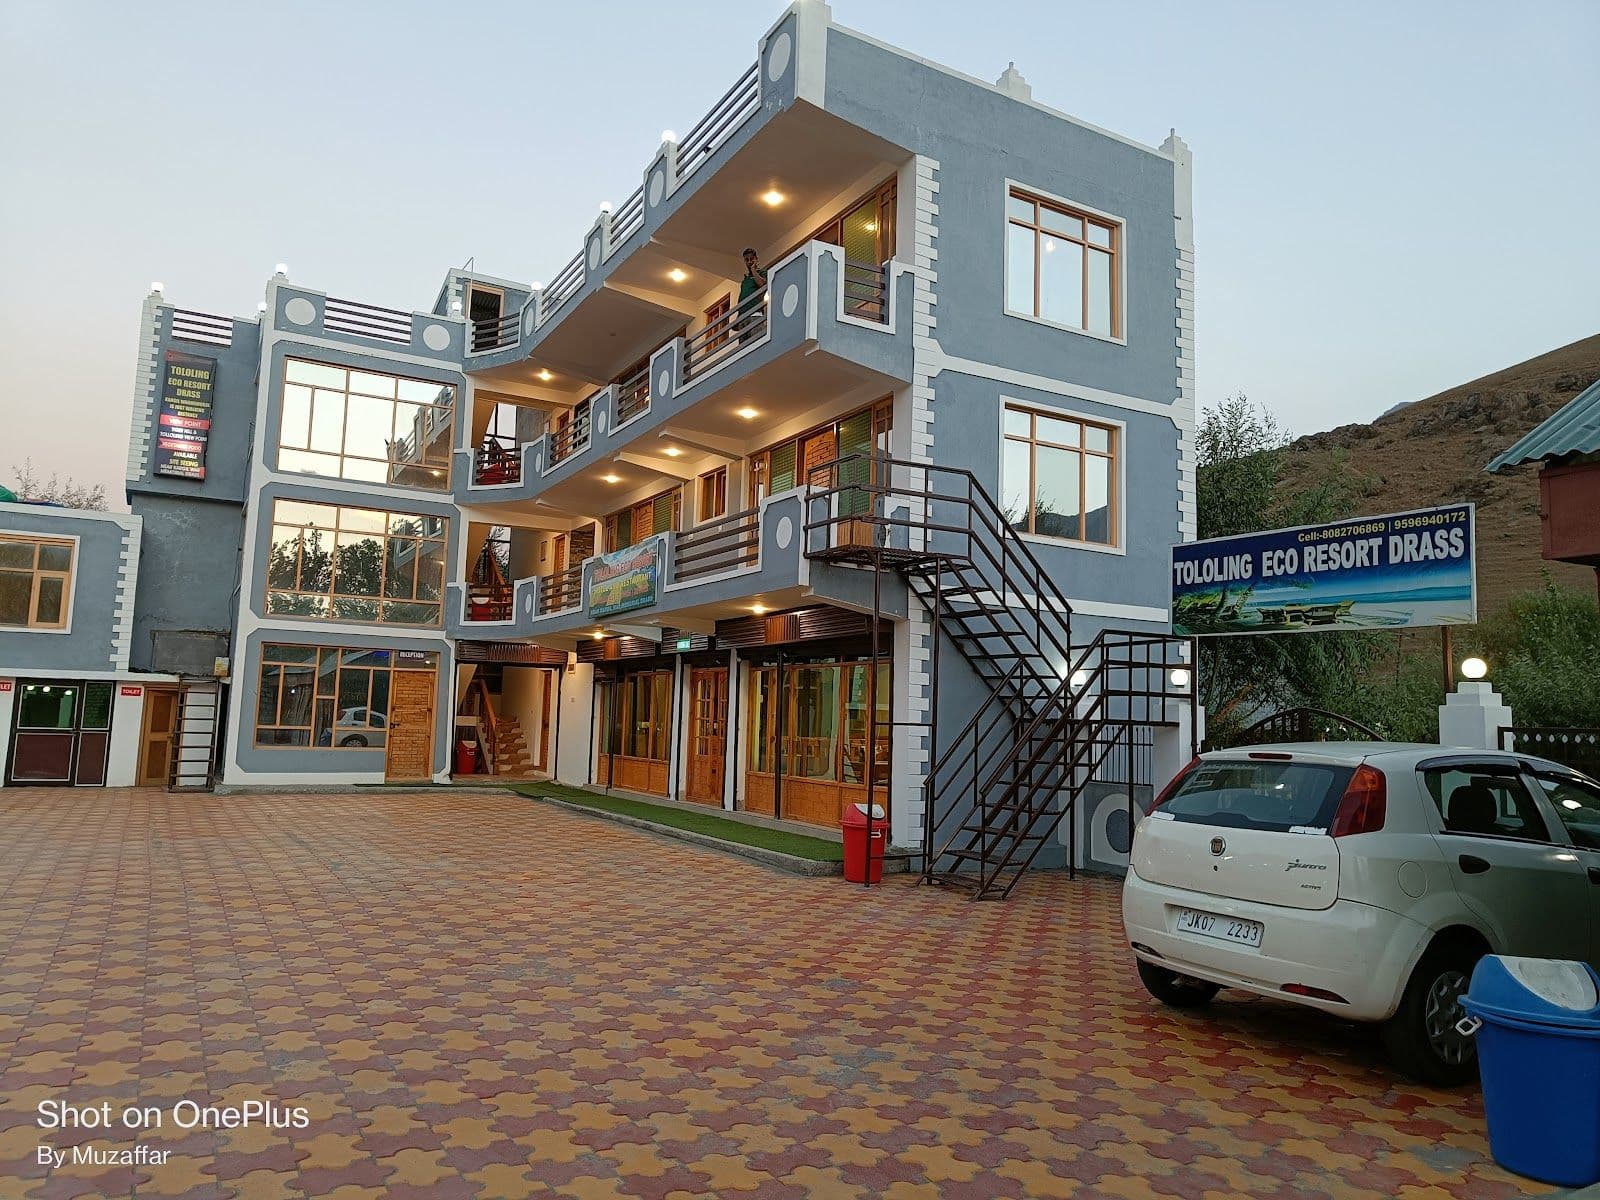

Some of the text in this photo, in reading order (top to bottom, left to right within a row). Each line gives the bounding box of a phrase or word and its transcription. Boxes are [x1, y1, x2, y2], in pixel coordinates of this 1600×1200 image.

[171, 366, 210, 380] TOLOLING
[168, 378, 211, 391] ECO RESORT
[176, 388, 201, 399] DRASS
[1298, 511, 1466, 542] Cell:-8082706869 9596940172
[1174, 528, 1464, 585] TOLOLING ECO RESORT DRASS
[1187, 913, 1258, 941] JK07 2233
